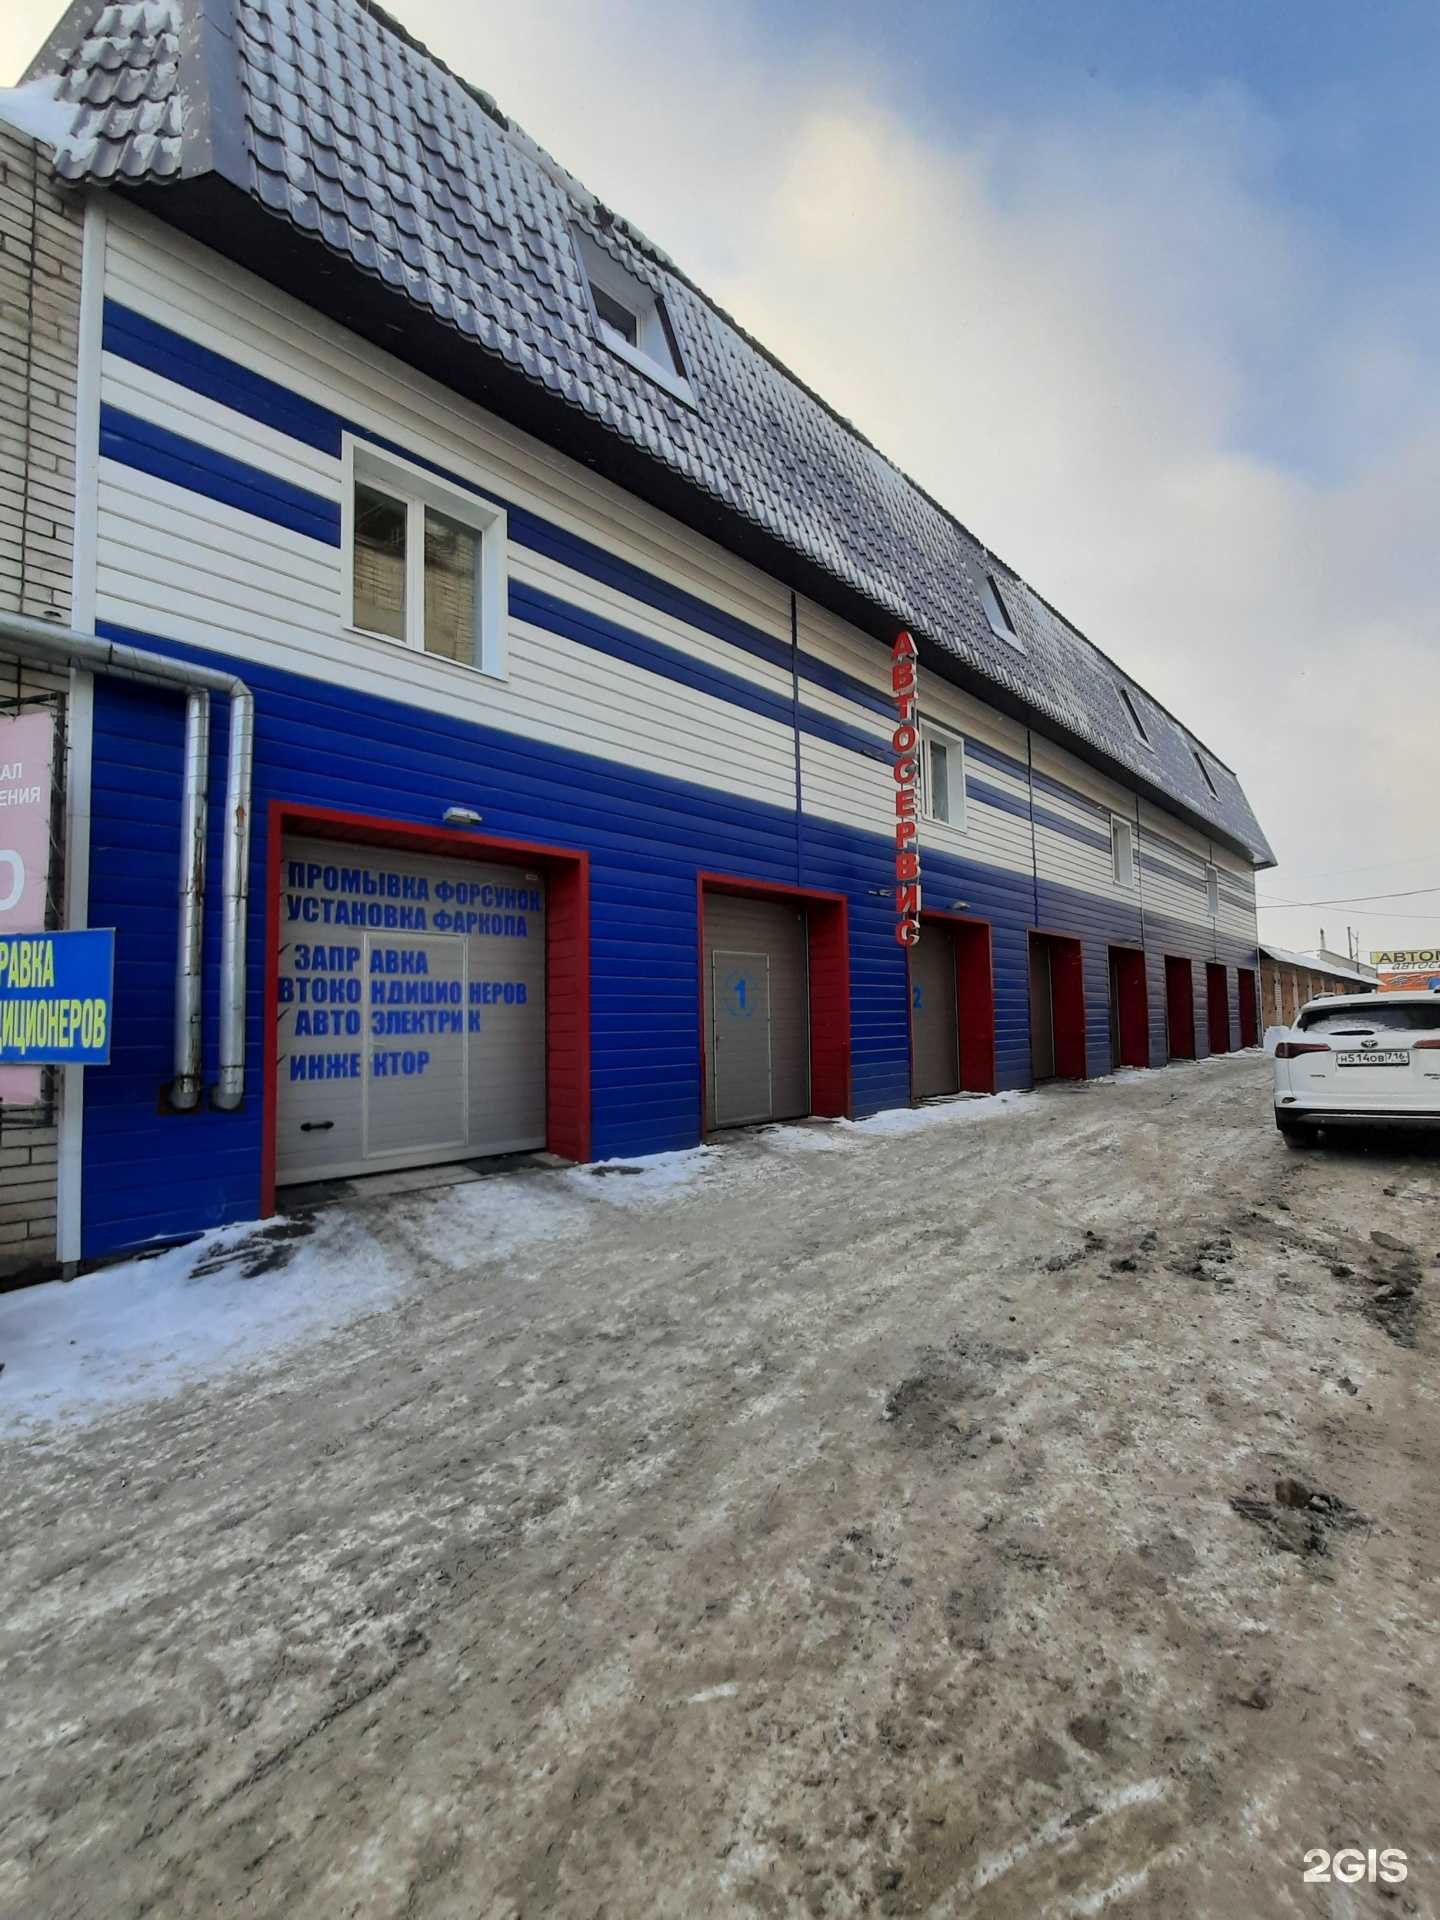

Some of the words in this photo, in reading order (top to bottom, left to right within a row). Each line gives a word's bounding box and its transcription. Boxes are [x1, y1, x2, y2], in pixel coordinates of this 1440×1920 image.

[892, 631, 921, 945] АВТОСЕРВИС
[287, 861, 429, 901] ПРОМЫВКА
[434, 881, 541, 912] ФОРСУНОК
[286, 894, 427, 931] УСТАНОВКА
[432, 909, 528, 937] ФАРКОПА
[1379, 951, 1440, 963] АВТО
[1391, 961, 1440, 970] автос
[0, 998, 106, 1055] ИЦИОНЕРОВ
